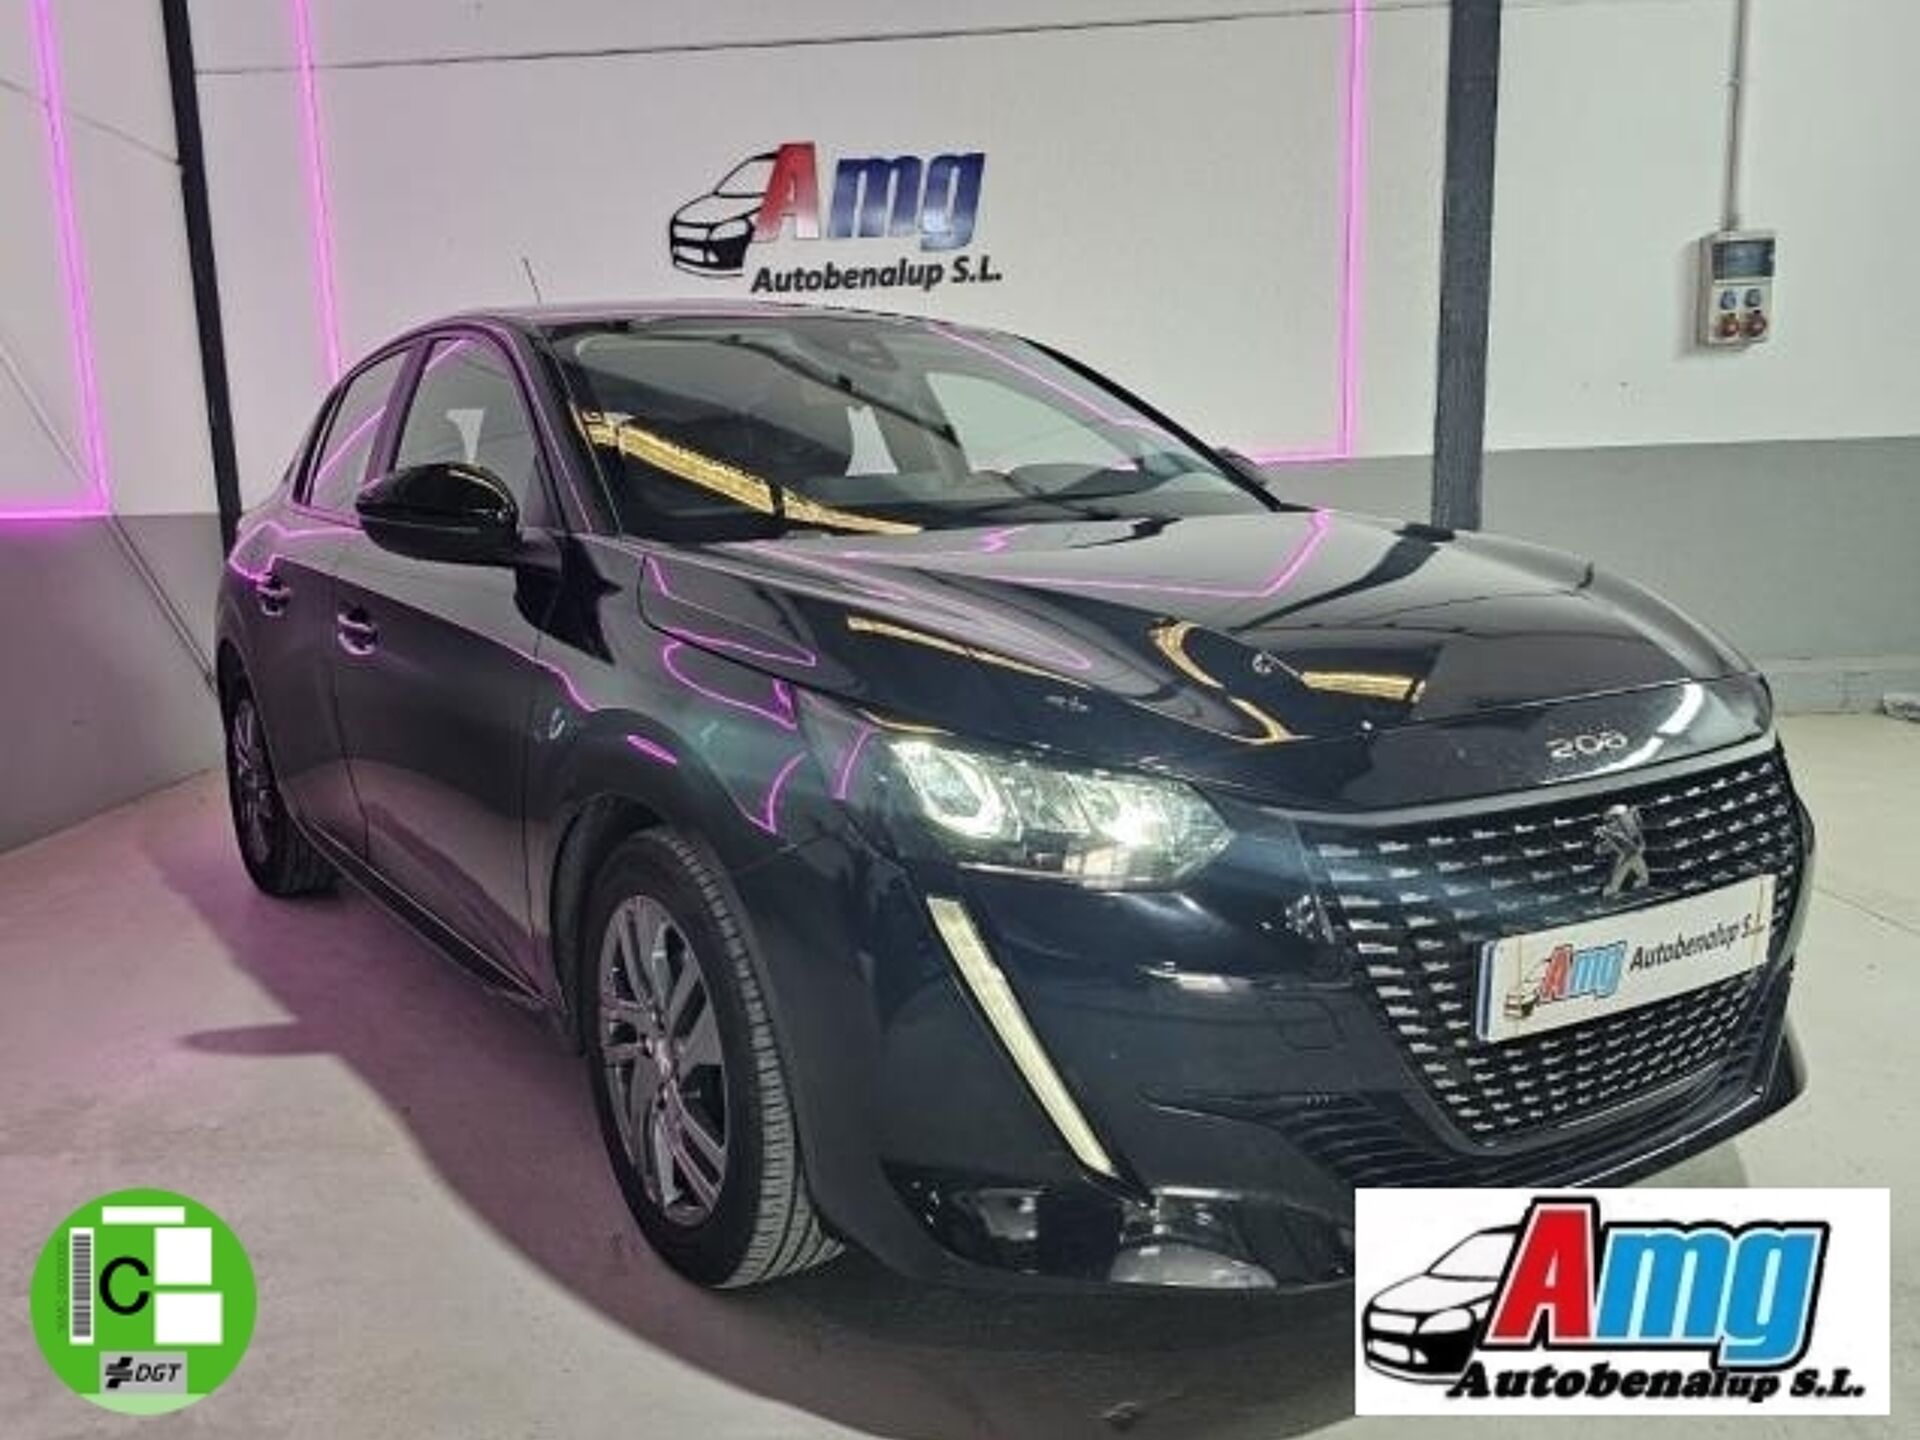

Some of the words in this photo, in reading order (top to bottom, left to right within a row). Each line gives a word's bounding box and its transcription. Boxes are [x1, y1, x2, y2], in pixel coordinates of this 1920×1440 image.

[752, 141, 986, 251] Amg
[751, 258, 944, 292] Autobenalup
[952, 256, 1003, 283] S.L.
